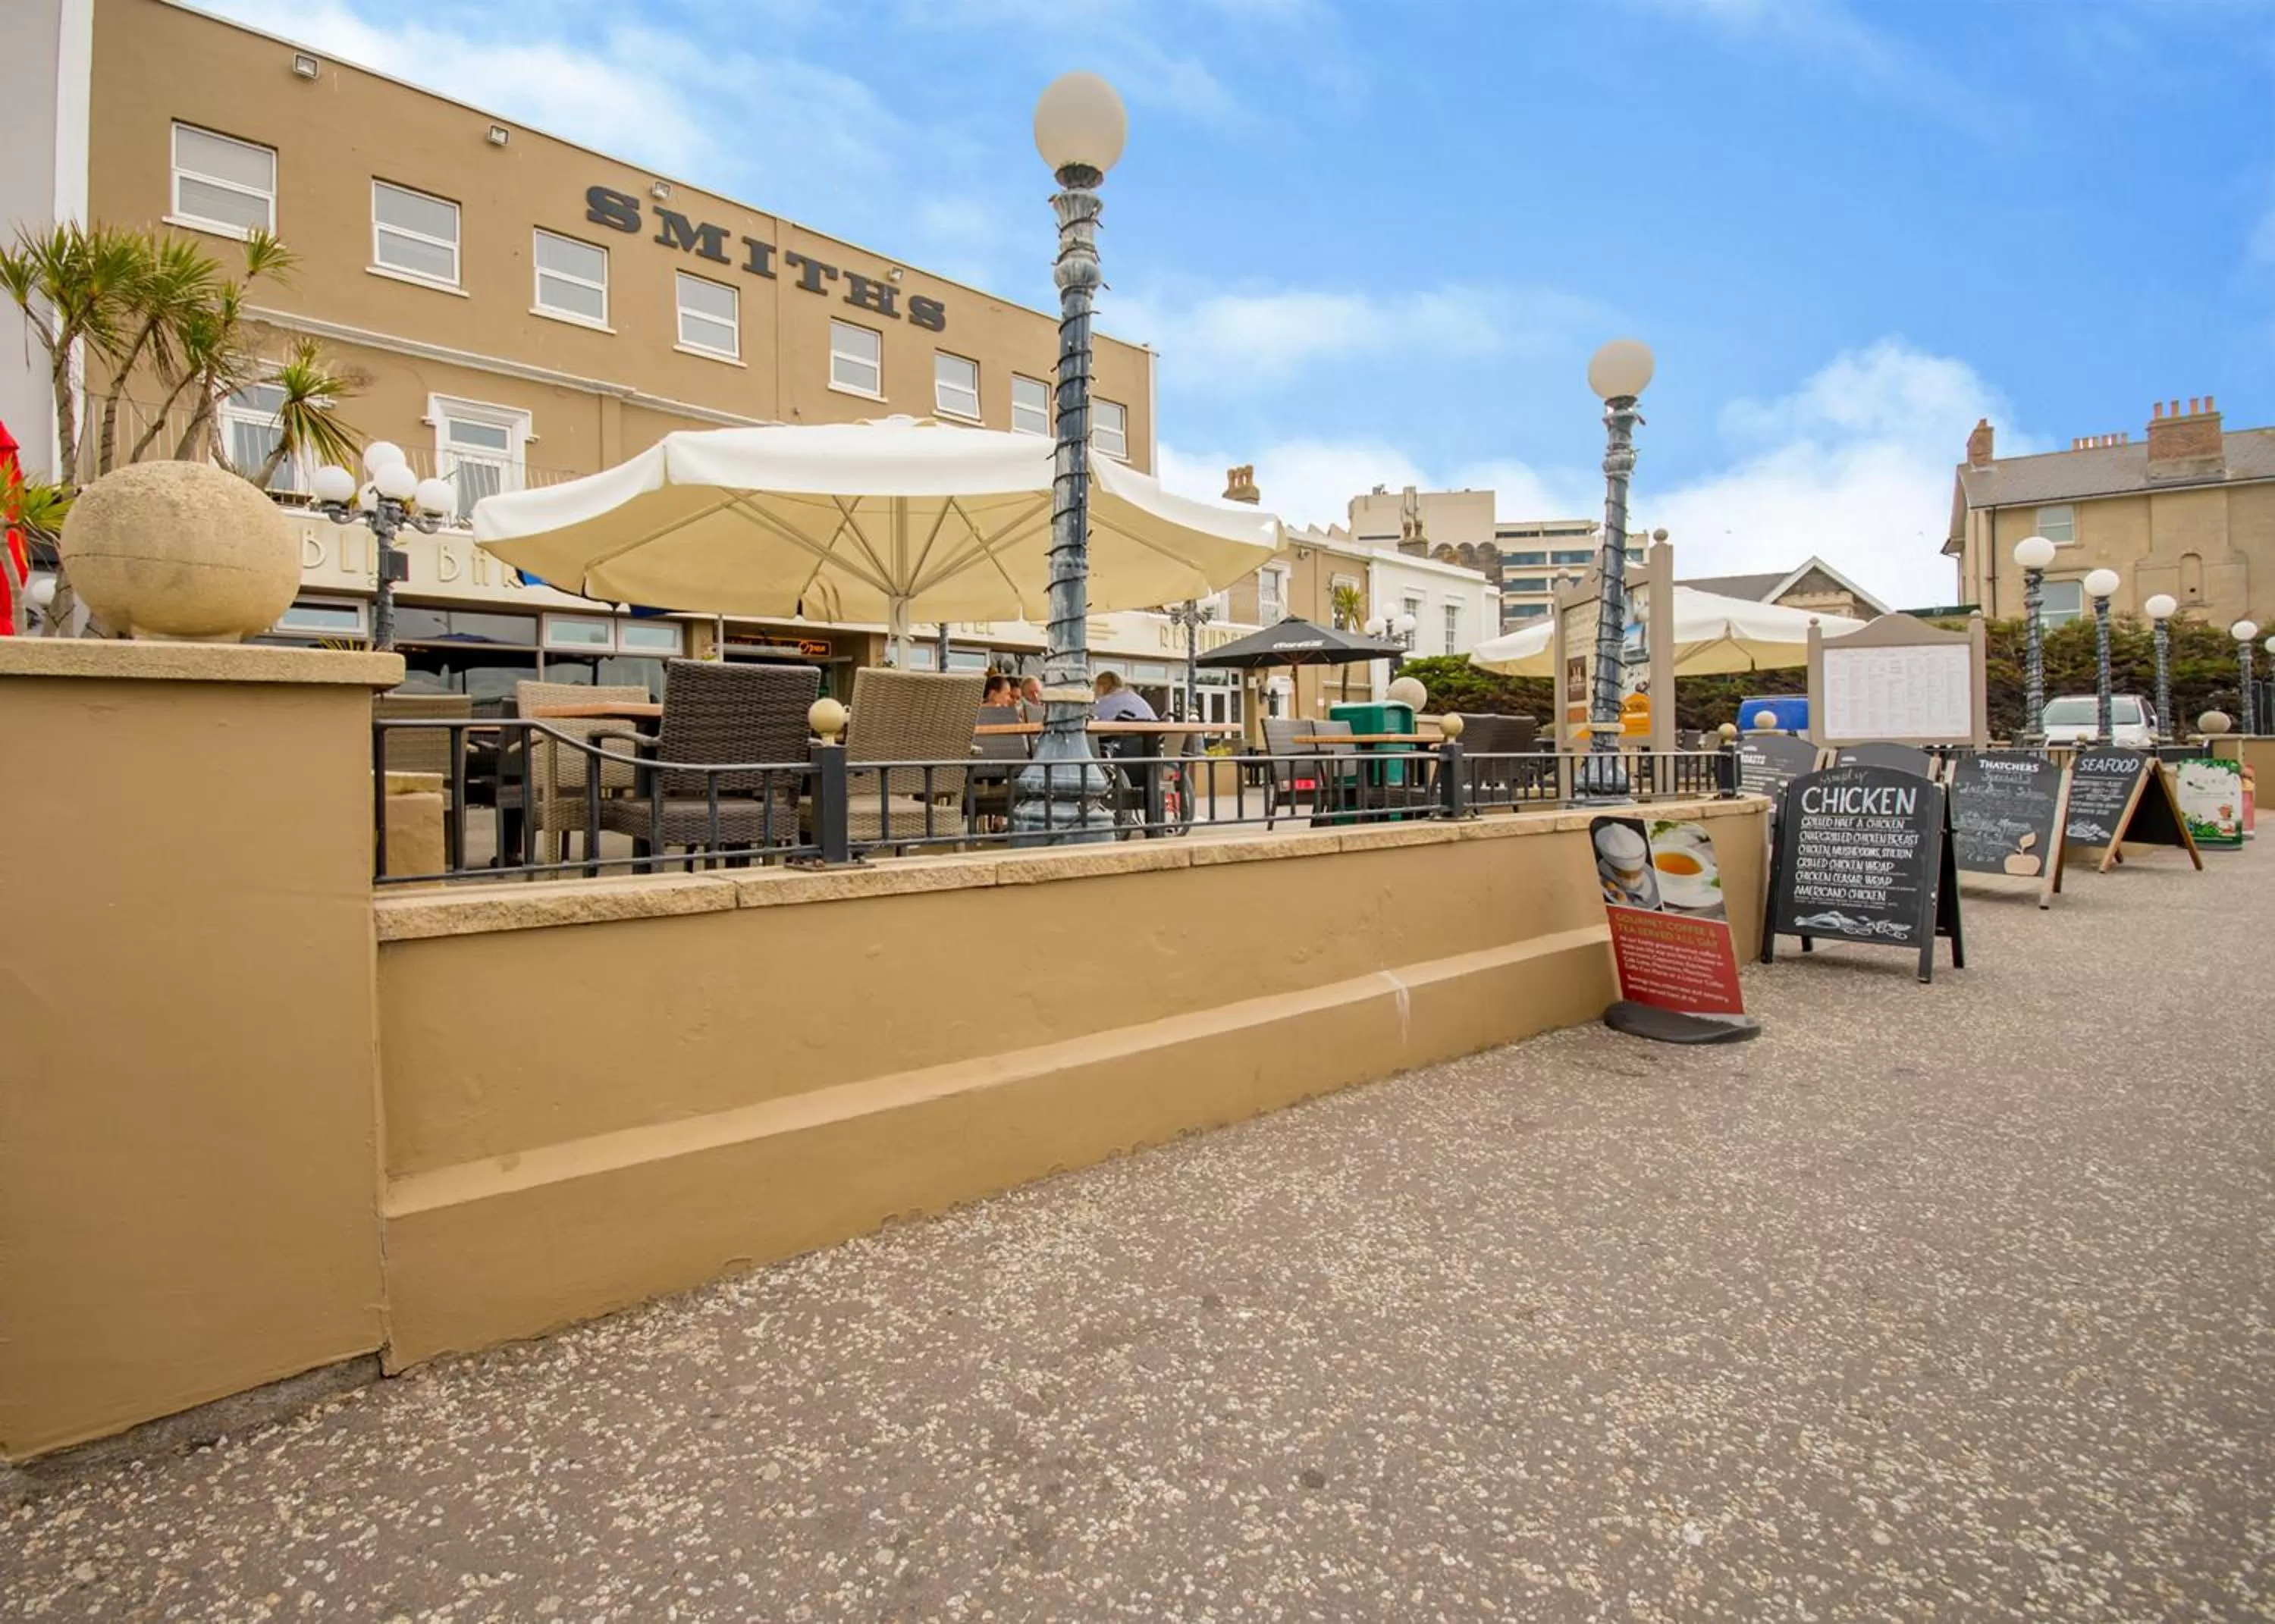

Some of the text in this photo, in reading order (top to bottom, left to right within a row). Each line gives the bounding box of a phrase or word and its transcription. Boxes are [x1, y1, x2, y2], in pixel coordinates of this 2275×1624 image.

[586, 185, 946, 332] SMITHS
[1978, 759, 2040, 773] THATCHERS
[2079, 758, 2139, 773] SEAFOOD
[1801, 786, 1917, 815] CHICKEN
[1856, 820, 1863, 828] A
[1866, 820, 1905, 830] CHICKEN
[1853, 832, 1887, 844] CHICKEN
[1887, 834, 1919, 845] BREAST
[1796, 857, 1895, 872] GRILLED CHICKEN WRAP
[1795, 870, 1831, 882] CHICKEN
[1865, 875, 1893, 886] WRAP
[1848, 889, 1886, 901] CHICKEN
